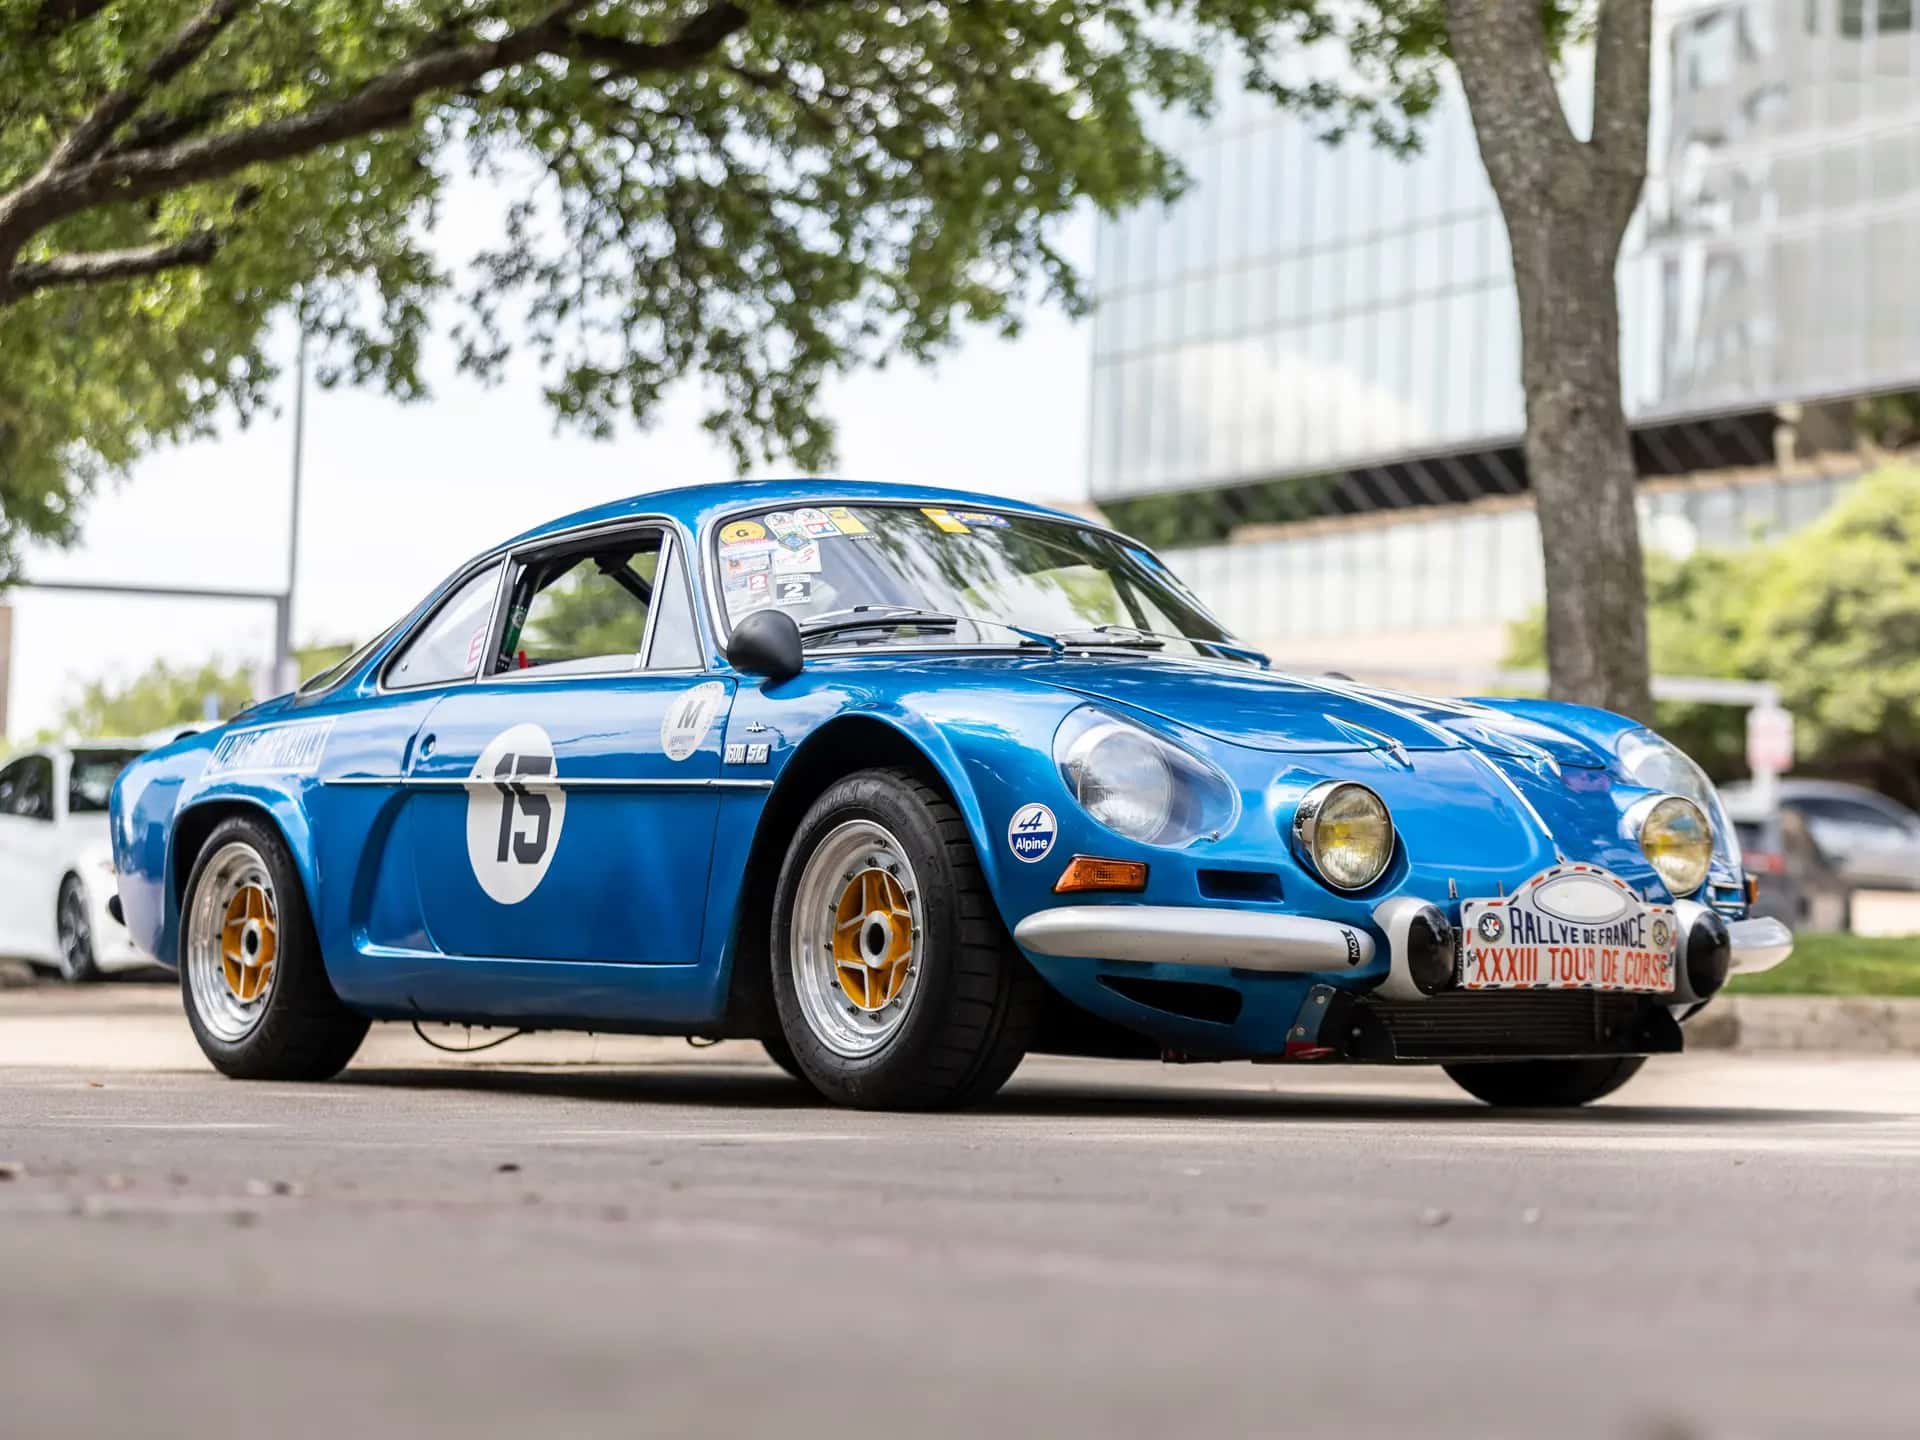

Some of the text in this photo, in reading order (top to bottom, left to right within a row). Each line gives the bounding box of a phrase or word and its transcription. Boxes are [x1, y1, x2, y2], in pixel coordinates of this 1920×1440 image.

[783, 583, 804, 598] 2
[678, 699, 704, 729] M
[494, 753, 553, 864] 15
[1015, 837, 1048, 853] Alpine
[1509, 906, 1580, 945] RALLYE
[1584, 929, 1597, 944] DE
[1598, 913, 1647, 949] FRANCE
[1348, 934, 1360, 958] TOW
[1474, 947, 1669, 987] XXXIII TOUR DE CORSE
